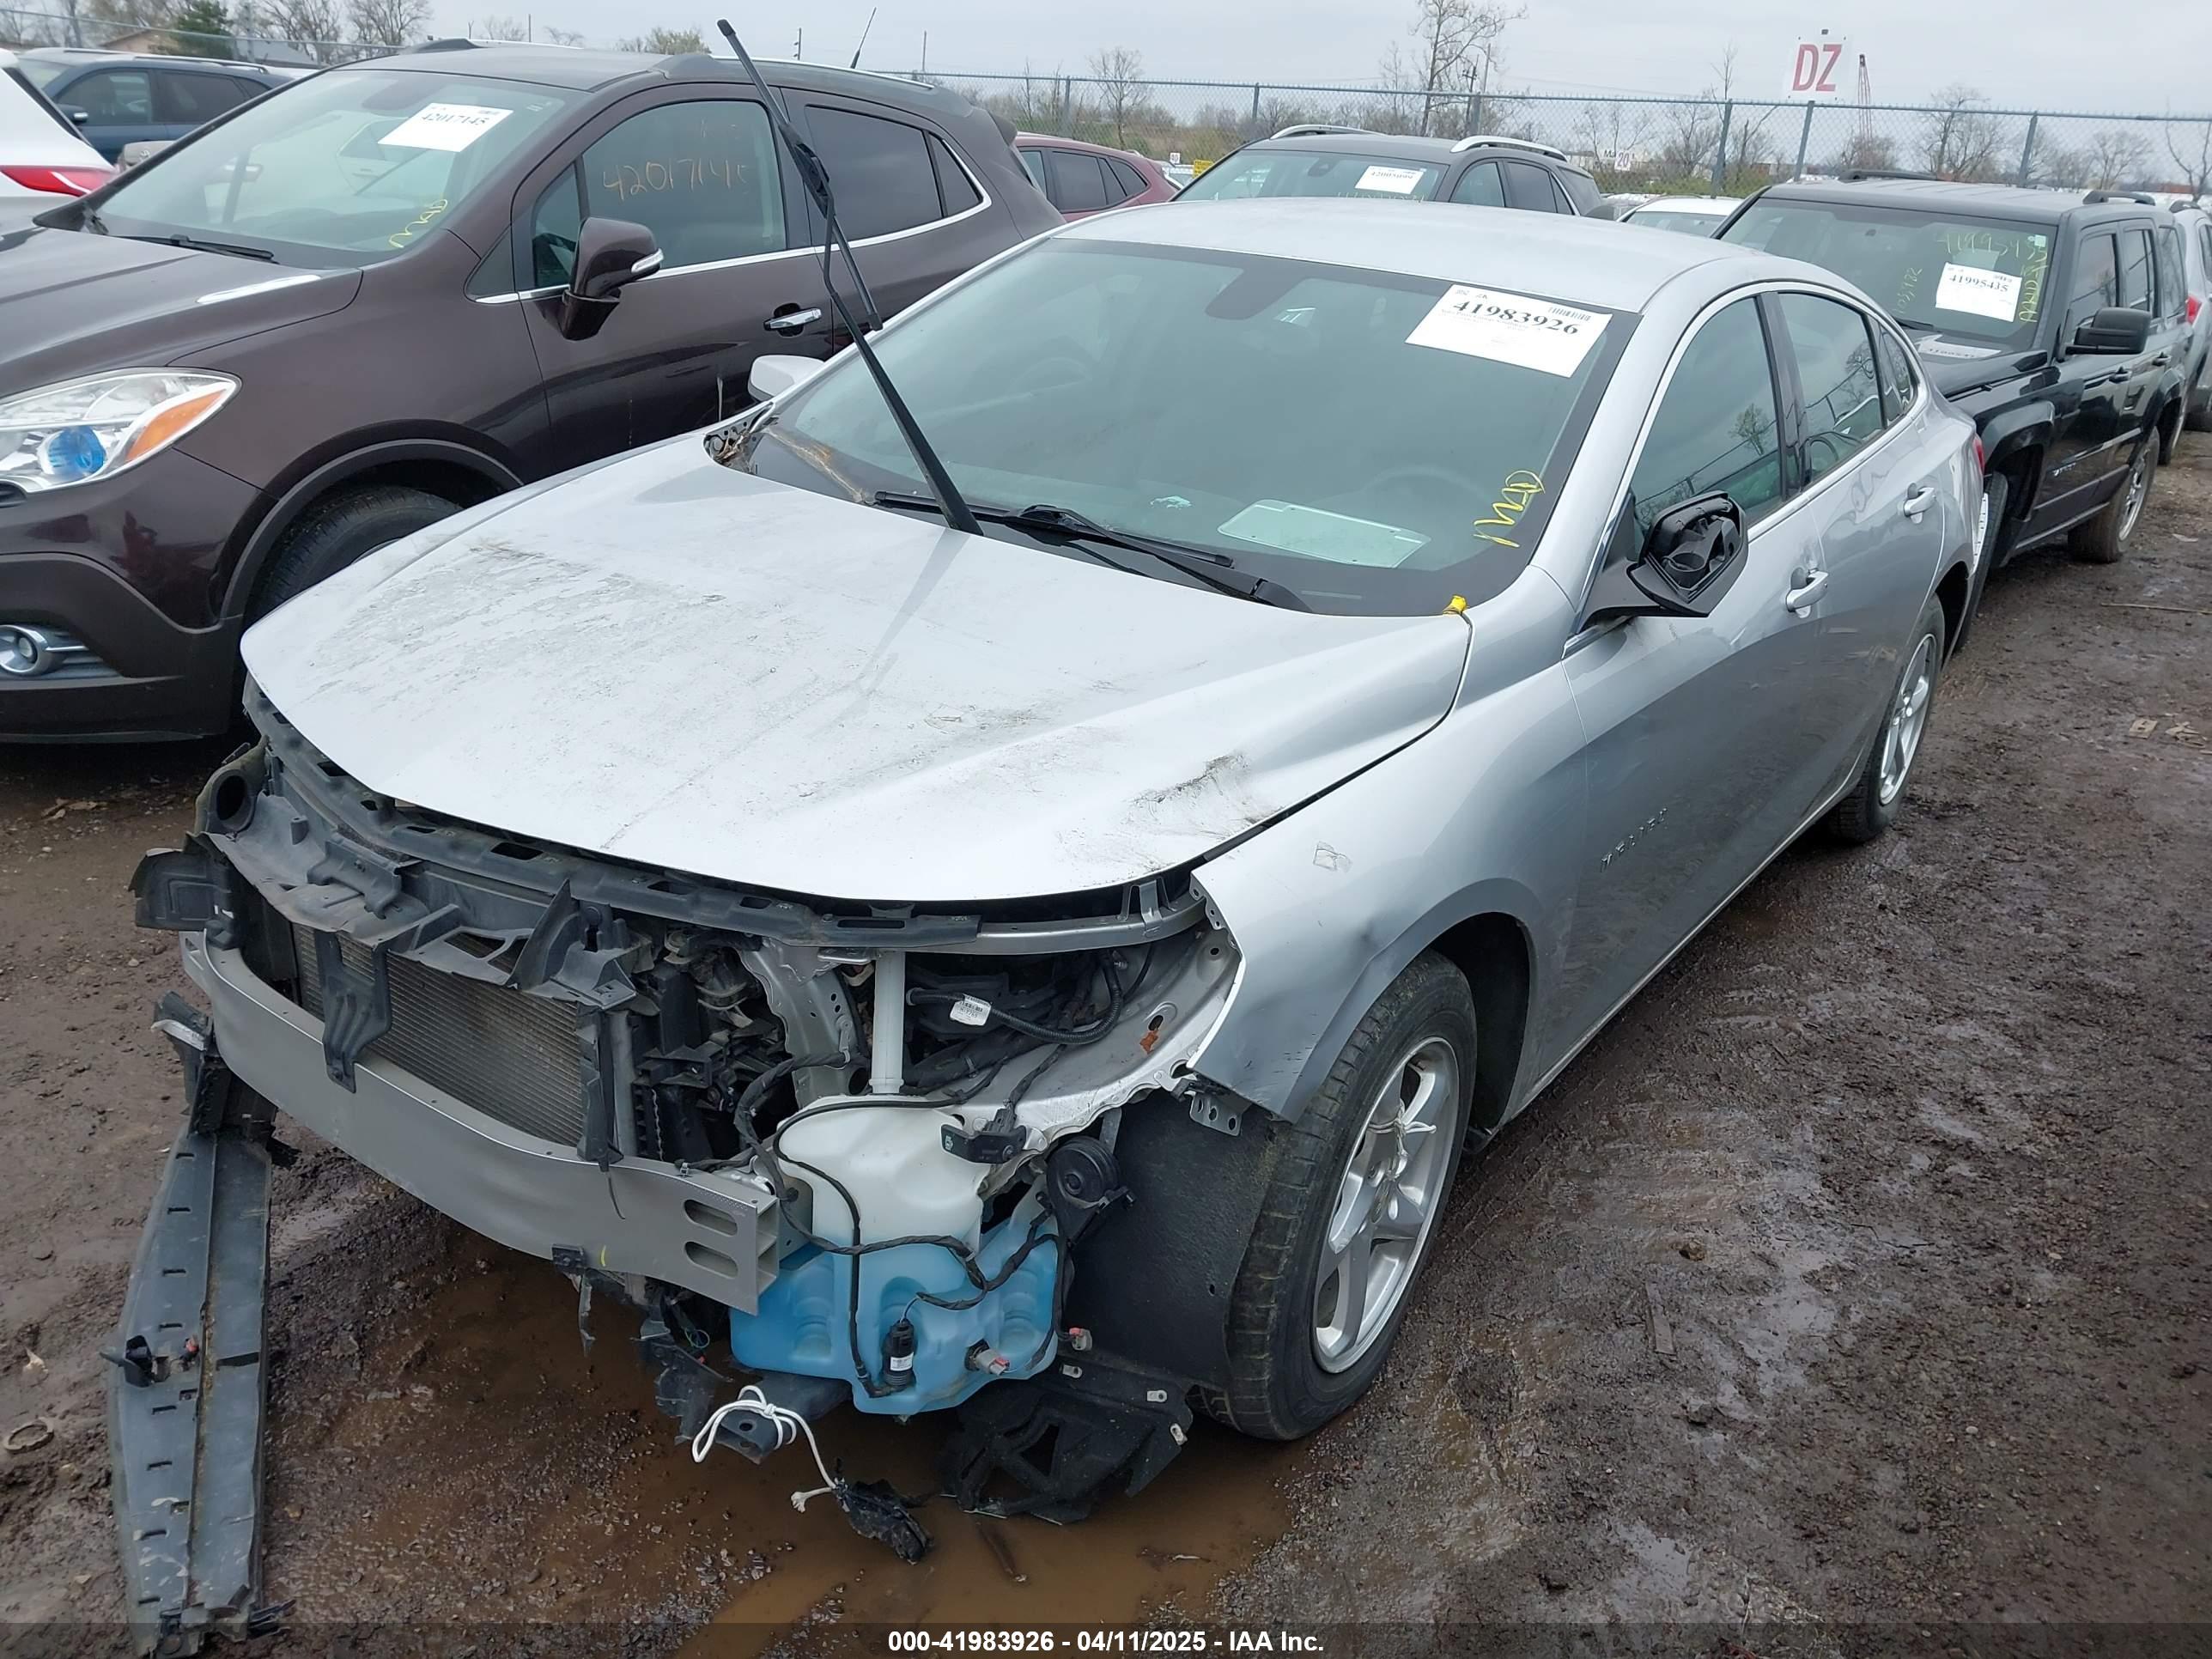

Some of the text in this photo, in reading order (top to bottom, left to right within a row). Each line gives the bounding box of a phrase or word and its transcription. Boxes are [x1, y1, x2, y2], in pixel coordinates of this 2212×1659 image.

[1792, 44, 1842, 91] DZ
[422, 112, 489, 125] 42017145
[1617, 152, 1630, 166] 20
[1948, 274, 2009, 293] 41995435
[1453, 301, 1578, 335] 41983926
